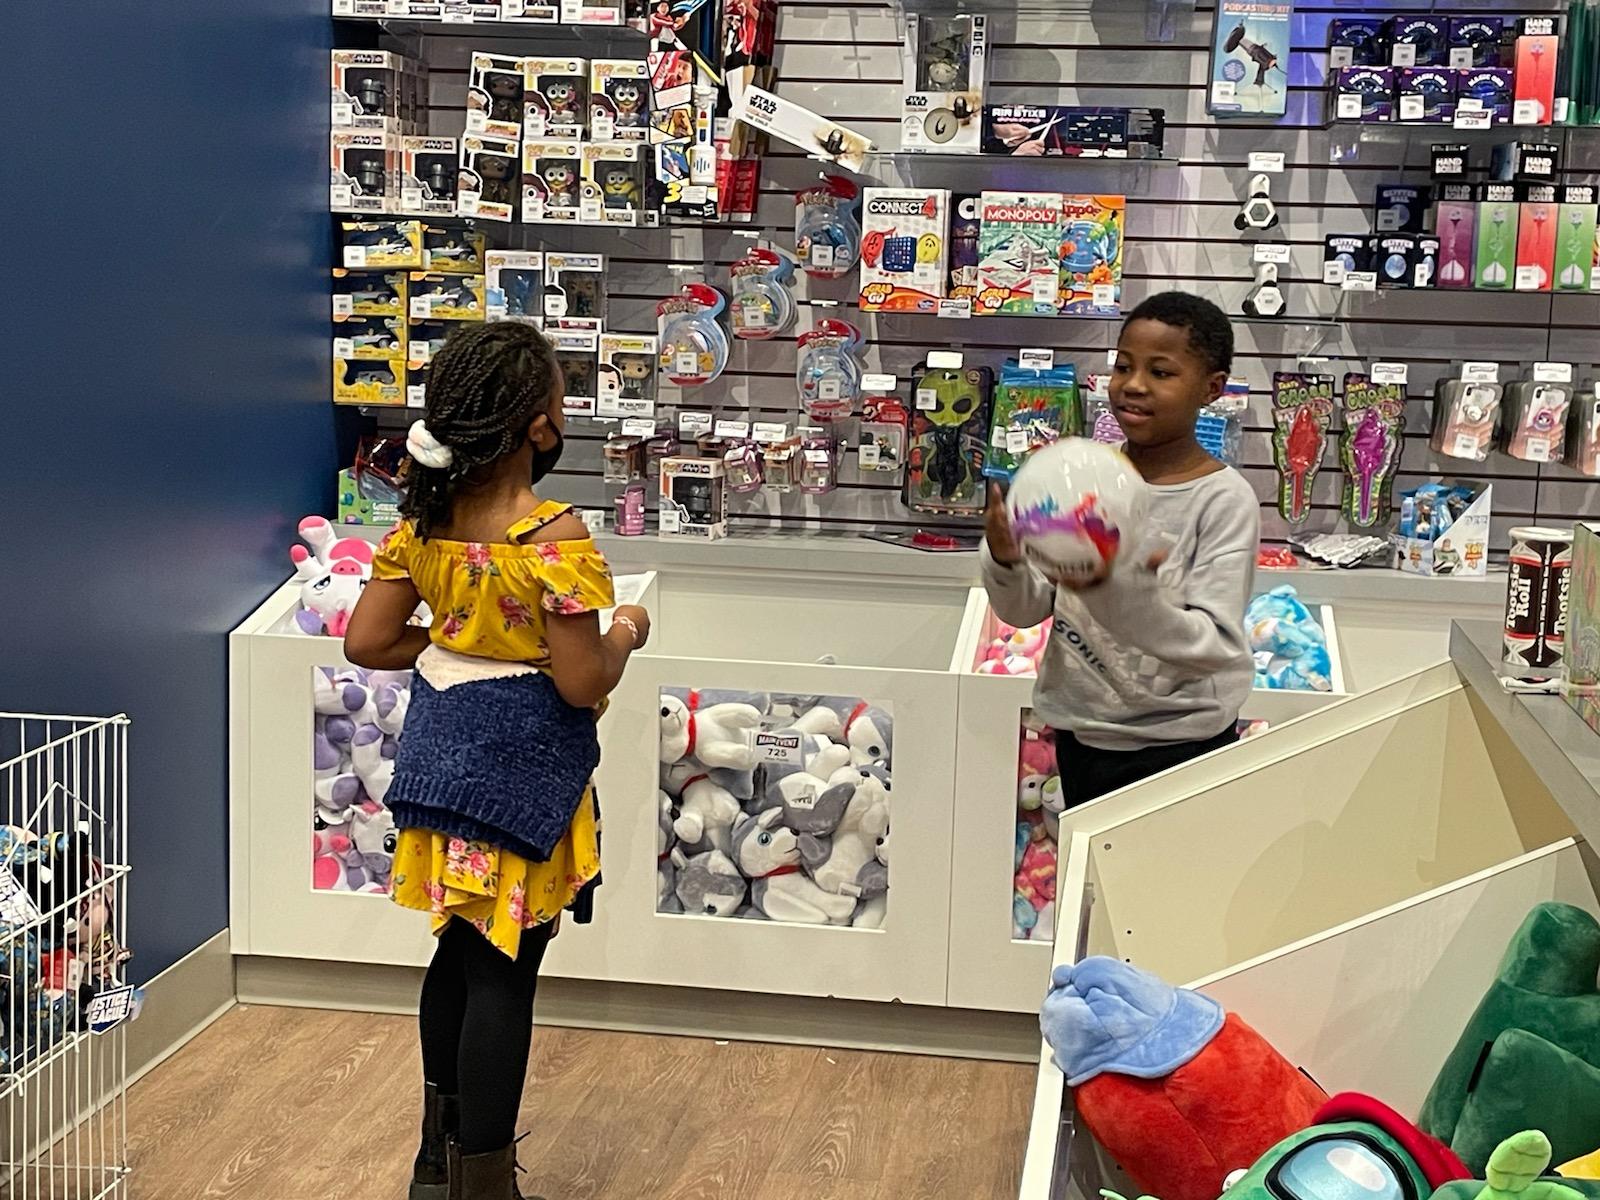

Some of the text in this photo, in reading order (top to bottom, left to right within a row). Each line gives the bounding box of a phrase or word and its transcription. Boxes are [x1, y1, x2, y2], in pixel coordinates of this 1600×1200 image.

[1525, 18, 1553, 27] HAND
[750, 100, 777, 114] WARS
[751, 95, 776, 108] STAR
[1435, 157, 1463, 165] HAND
[1525, 157, 1552, 166] HAND
[663, 182, 682, 203] 3
[1445, 185, 1471, 193] HAND
[1487, 185, 1514, 194] HAND
[1528, 186, 1555, 194] HAND
[1566, 187, 1593, 195] HAND
[869, 195, 937, 218] CONNECT 4
[987, 208, 1056, 221] MONOPOLY
[868, 284, 893, 294] GRAB
[987, 288, 1010, 298] GRAB
[868, 293, 886, 304] GO
[984, 296, 1002, 308] GO
[1465, 543, 1485, 553] TOY
[1506, 563, 1520, 629] Tootsie
[1516, 578, 1531, 618] Roll
[1553, 567, 1571, 635] Tootsie
[1055, 619, 1106, 673] SONIC
[760, 735, 798, 748] MAIN EVENT
[767, 748, 787, 757] 725
